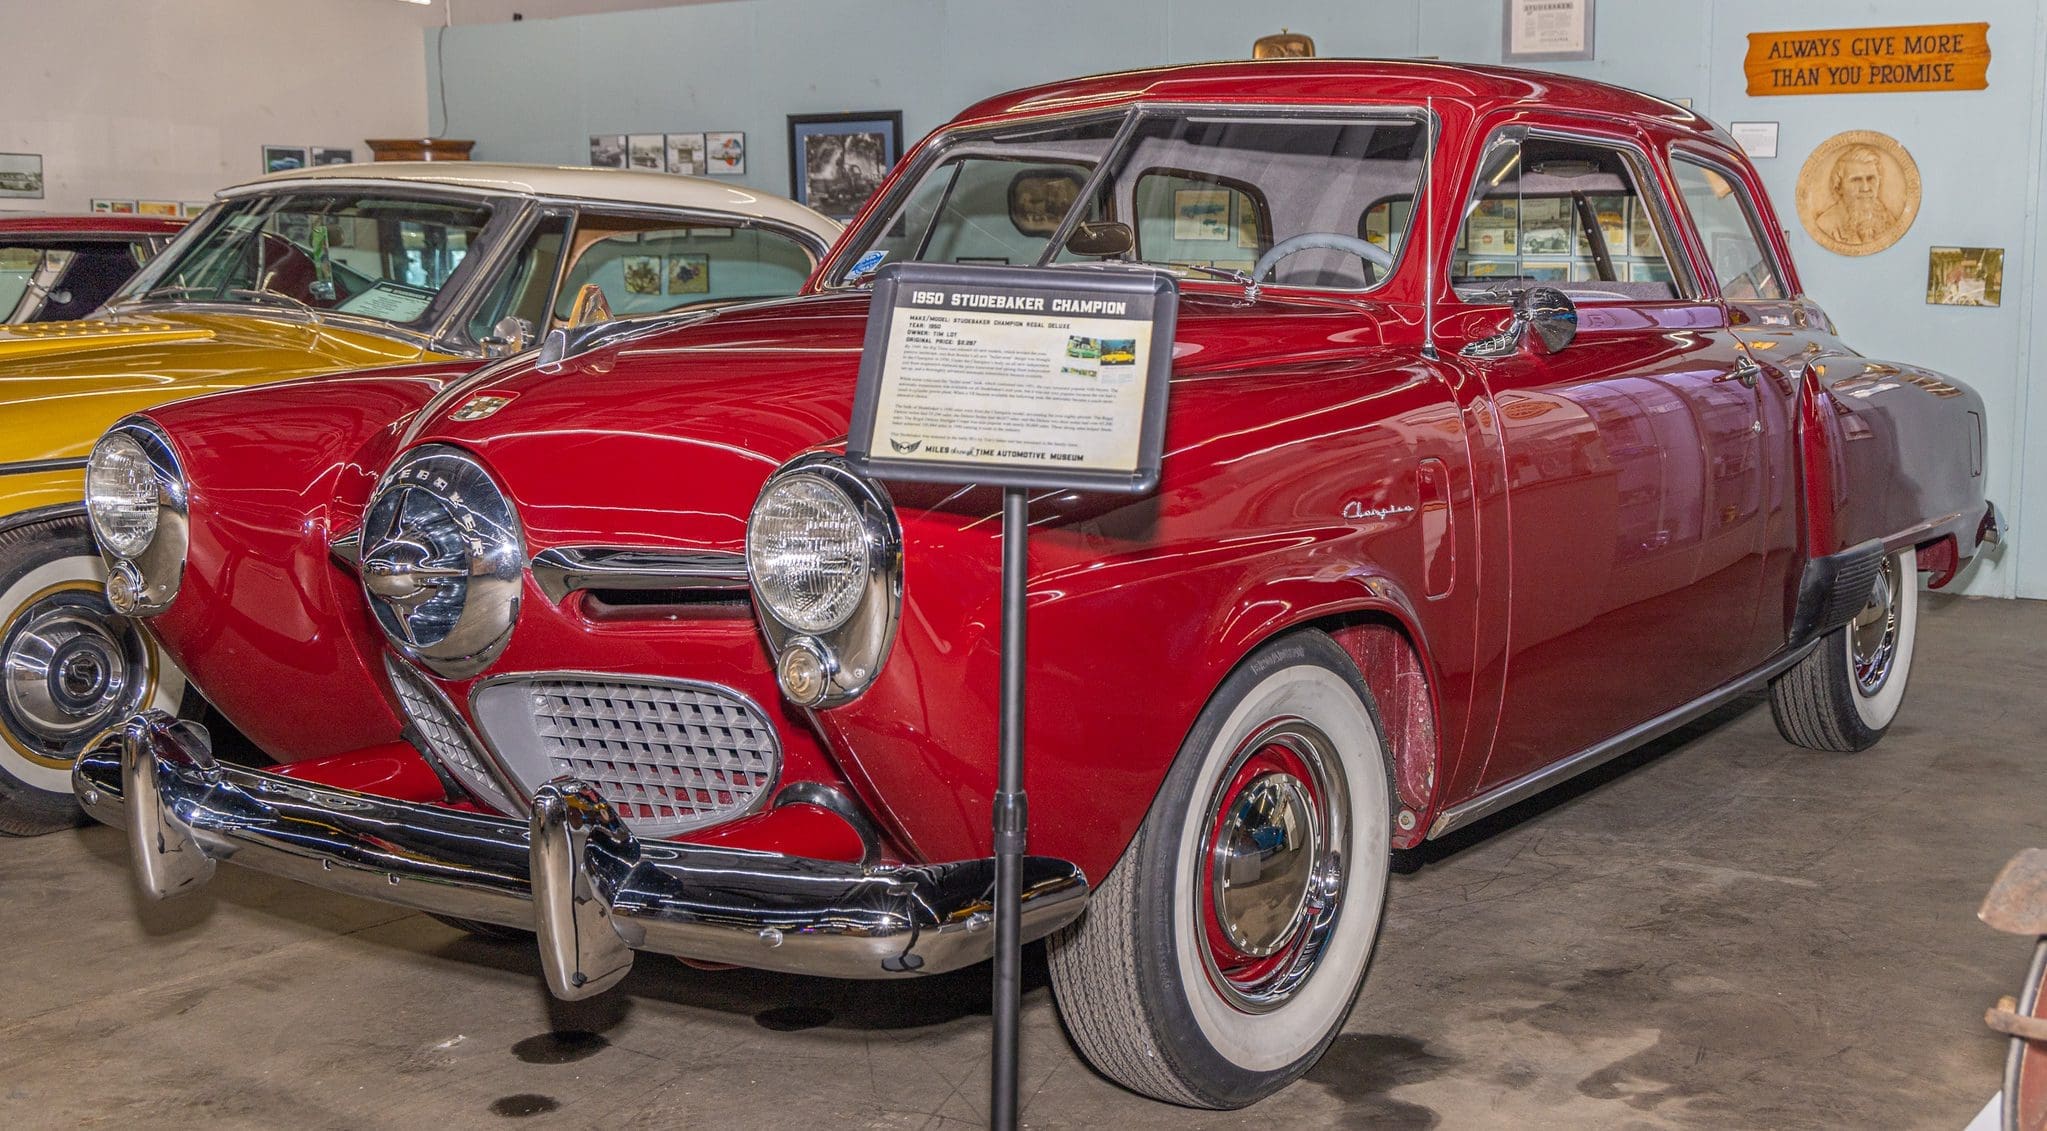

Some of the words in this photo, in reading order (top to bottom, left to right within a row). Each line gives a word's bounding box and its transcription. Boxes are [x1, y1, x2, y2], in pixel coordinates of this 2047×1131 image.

[1768, 39, 1840, 59] ALWAYS
[1852, 37, 1895, 56] GIVE
[1904, 34, 1964, 55] MORE
[1772, 68, 1819, 87] THAN
[1827, 66, 1861, 85] YOU
[1868, 64, 1955, 84] PROMISE
[912, 291, 944, 305] 1950
[951, 293, 1044, 311] STUDEBAKER
[1052, 299, 1126, 315] CHAMPION
[925, 446, 949, 454] MILES
[975, 448, 995, 457] TIME
[997, 450, 1046, 459] AUTOMOTIVE
[1050, 452, 1084, 462] MUSEUM
